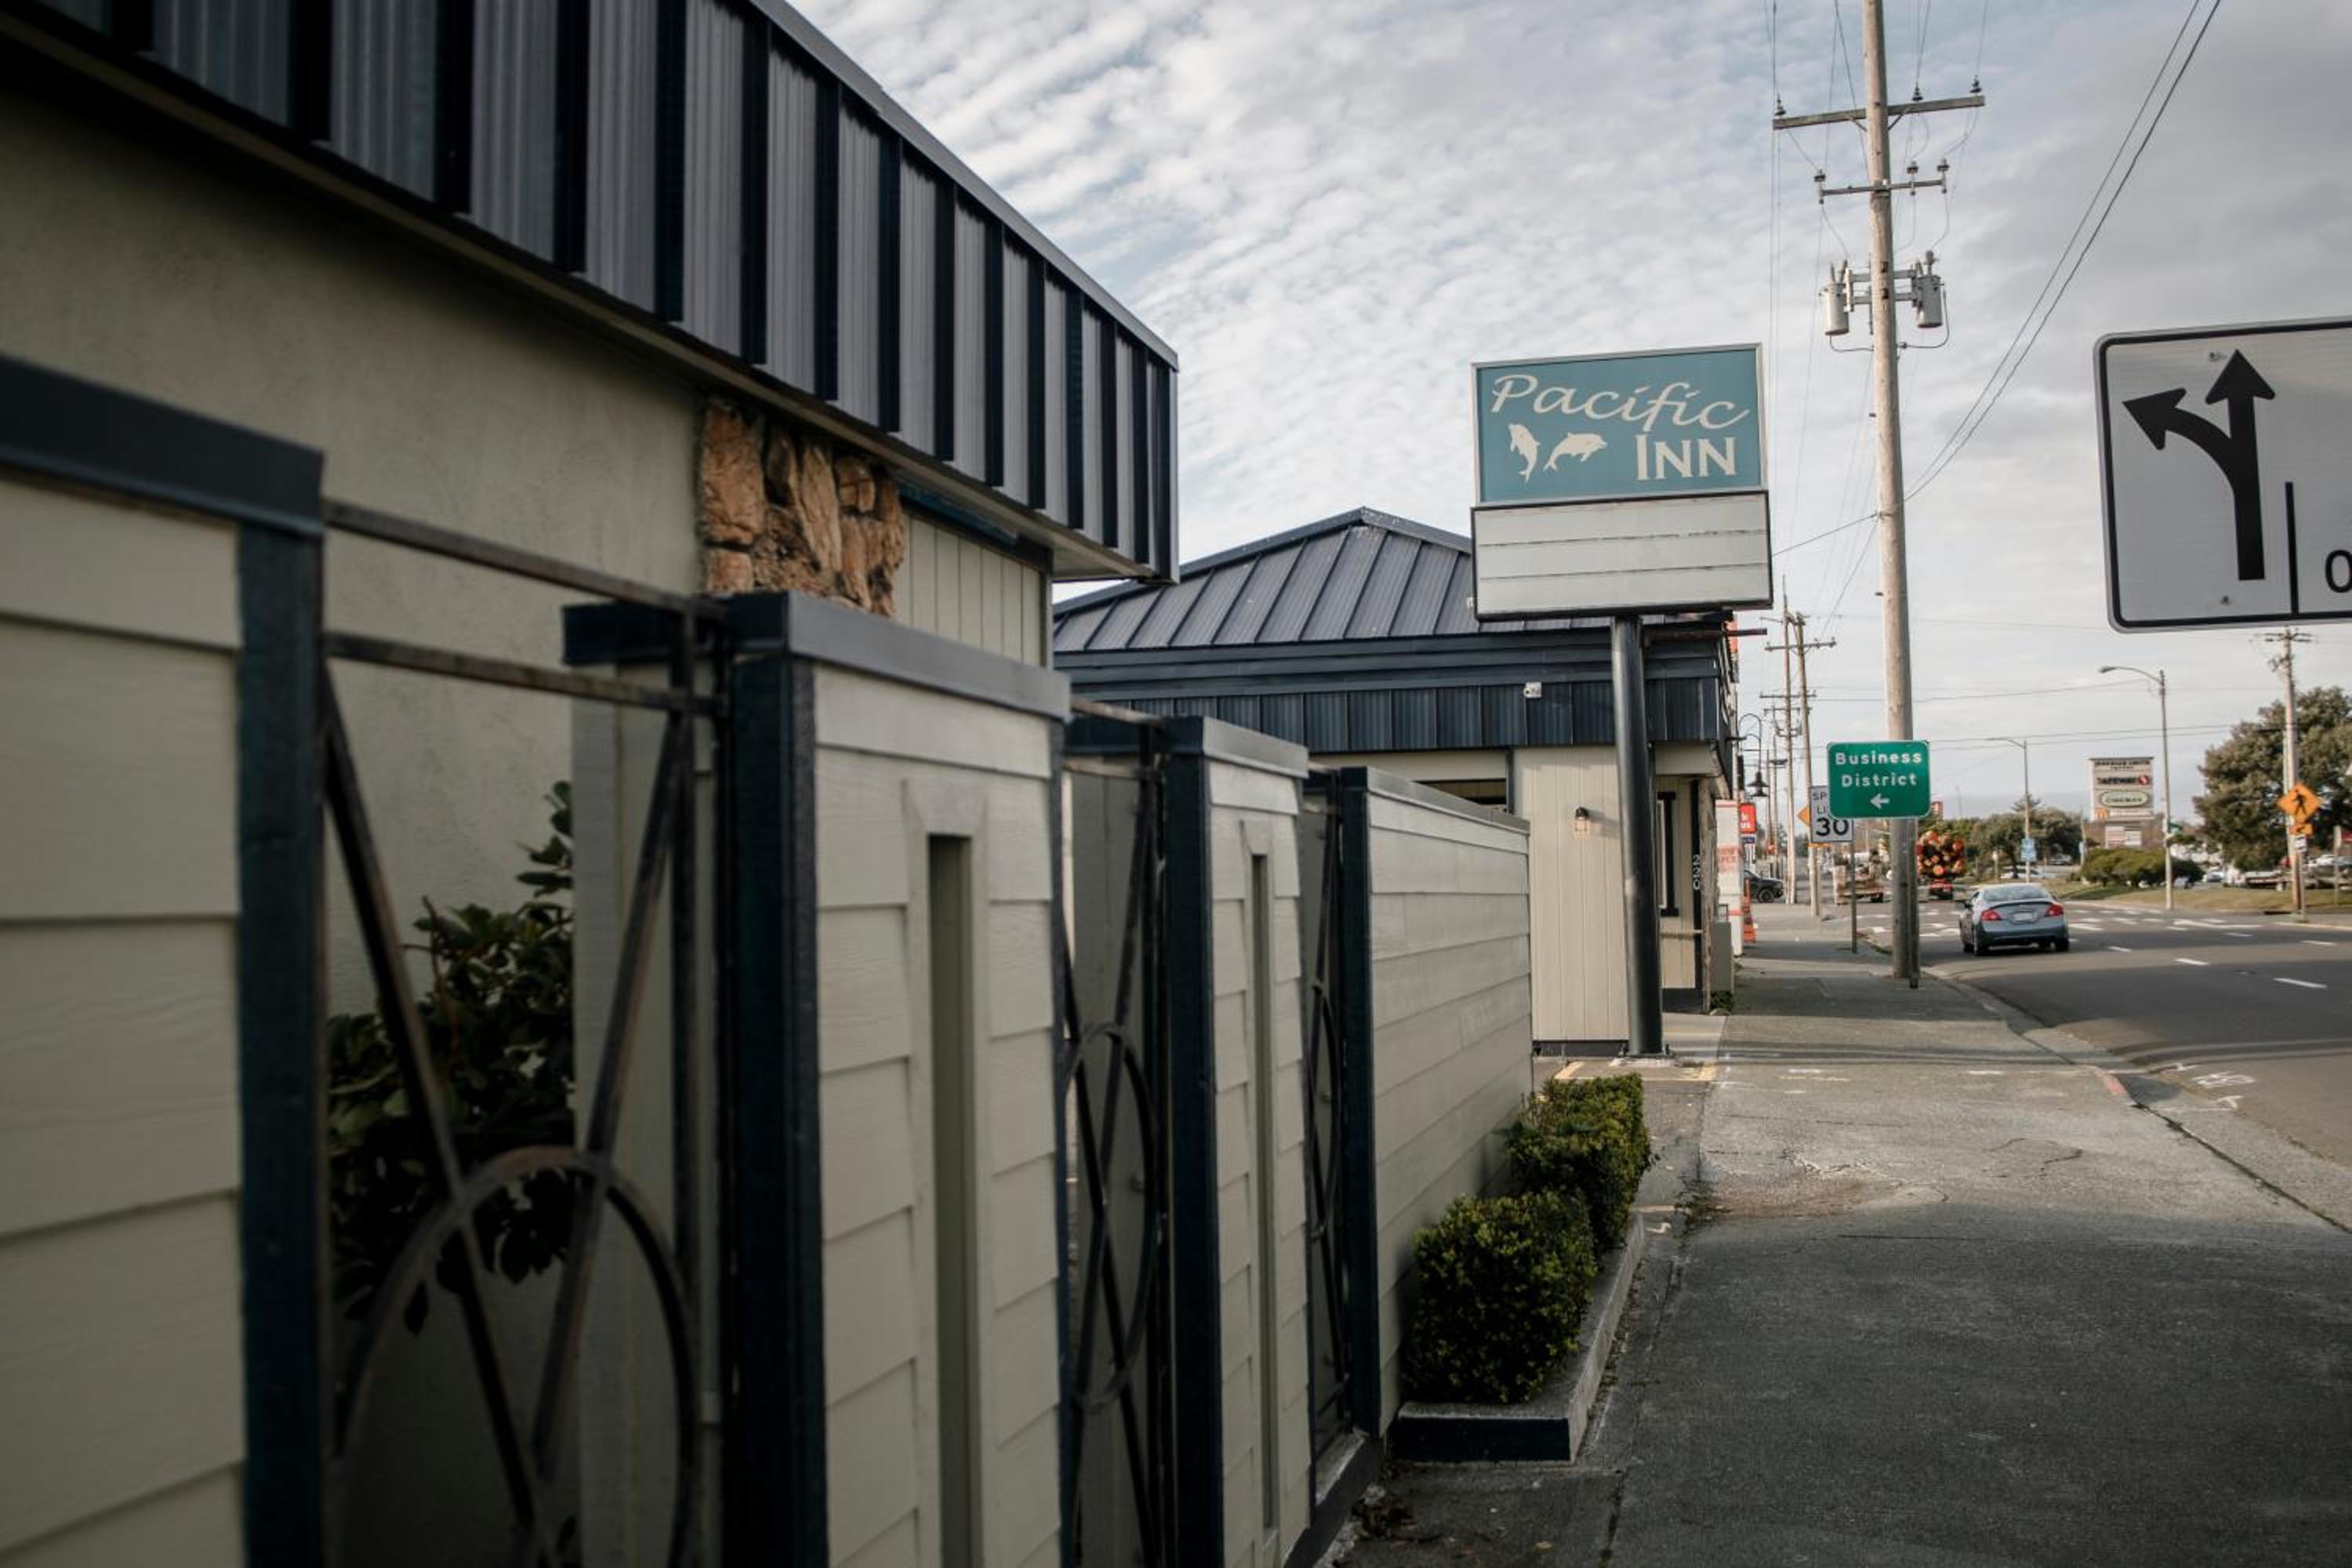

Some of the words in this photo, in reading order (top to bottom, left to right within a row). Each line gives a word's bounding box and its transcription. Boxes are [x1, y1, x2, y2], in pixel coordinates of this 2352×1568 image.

[1492, 374, 1750, 432] Pacific
[1636, 433, 1737, 481] INN
[1835, 750, 1922, 765] Business
[1842, 772, 1918, 787] District
[1816, 817, 1849, 837] 30
